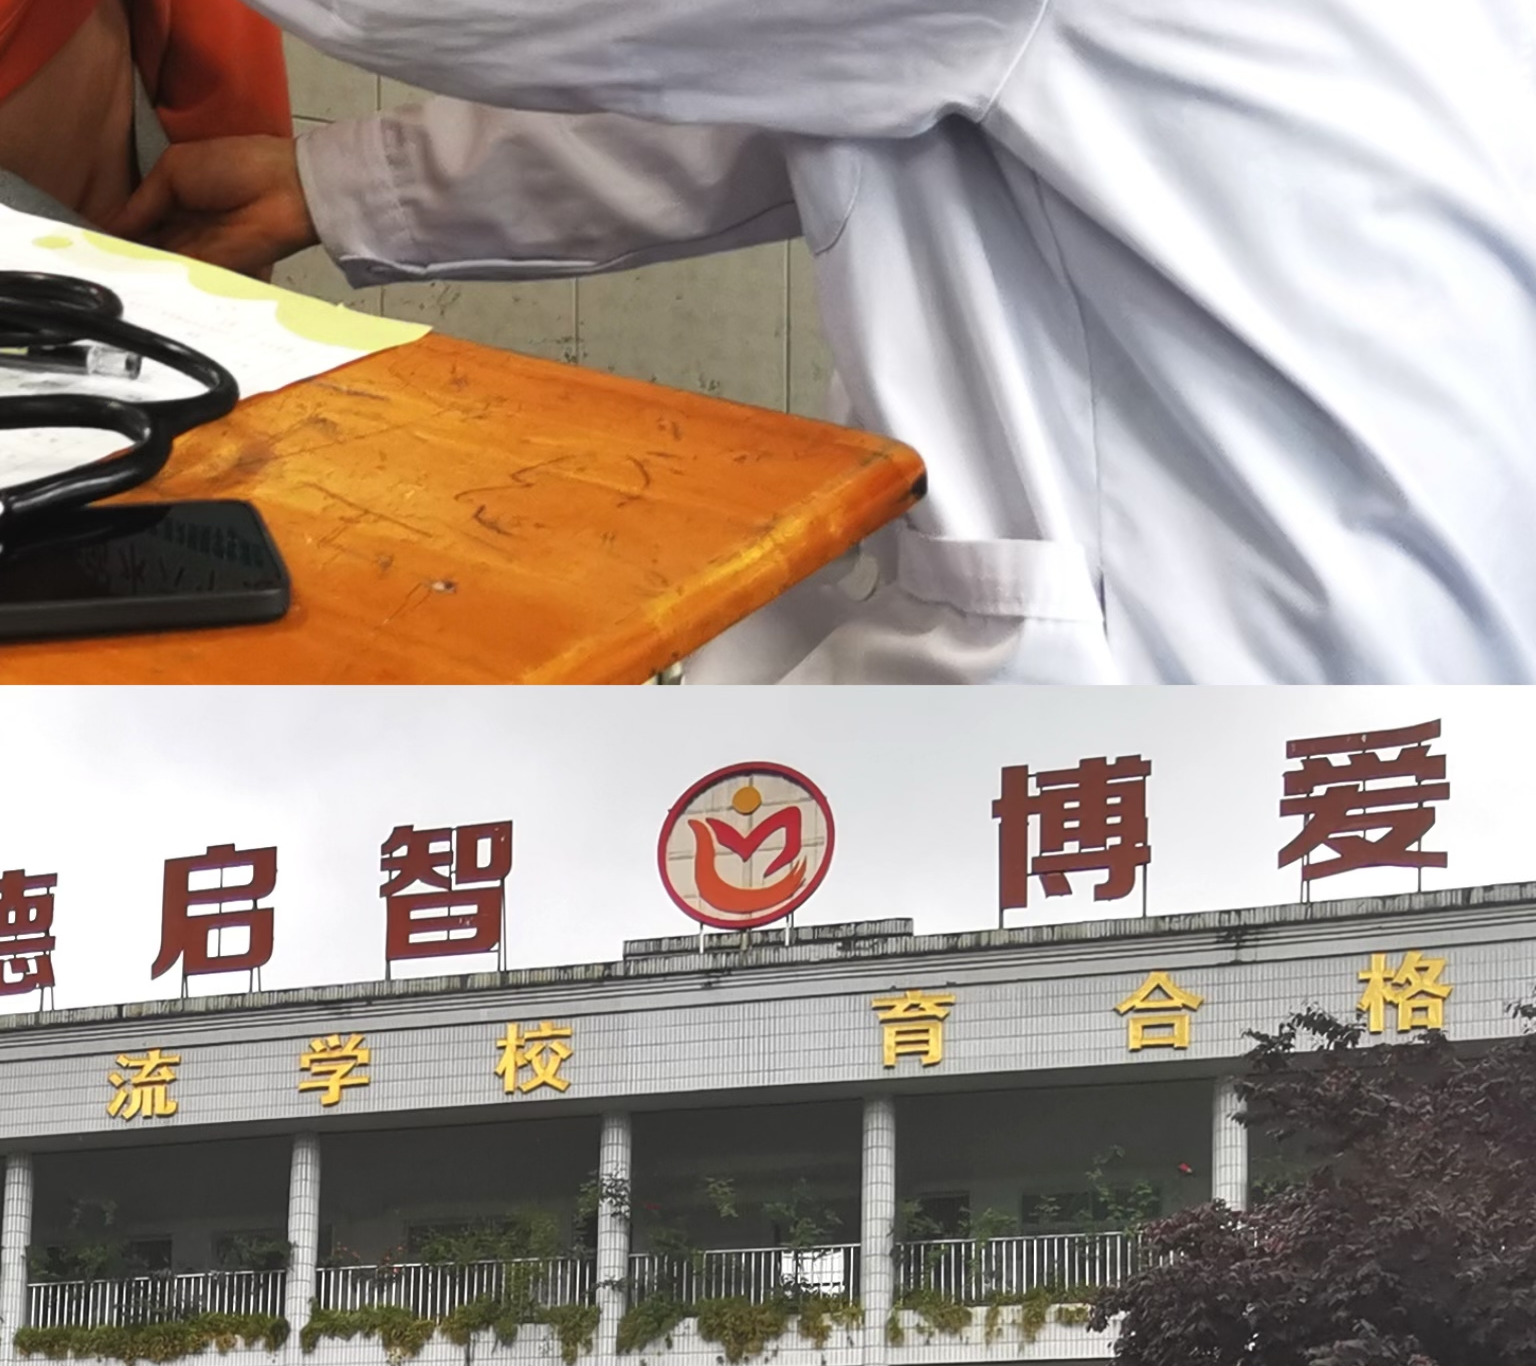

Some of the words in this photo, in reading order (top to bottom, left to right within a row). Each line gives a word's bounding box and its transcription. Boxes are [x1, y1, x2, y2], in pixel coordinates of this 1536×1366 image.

[992, 718, 1450, 910] 博爱
[872, 950, 1453, 1069] 育合格
